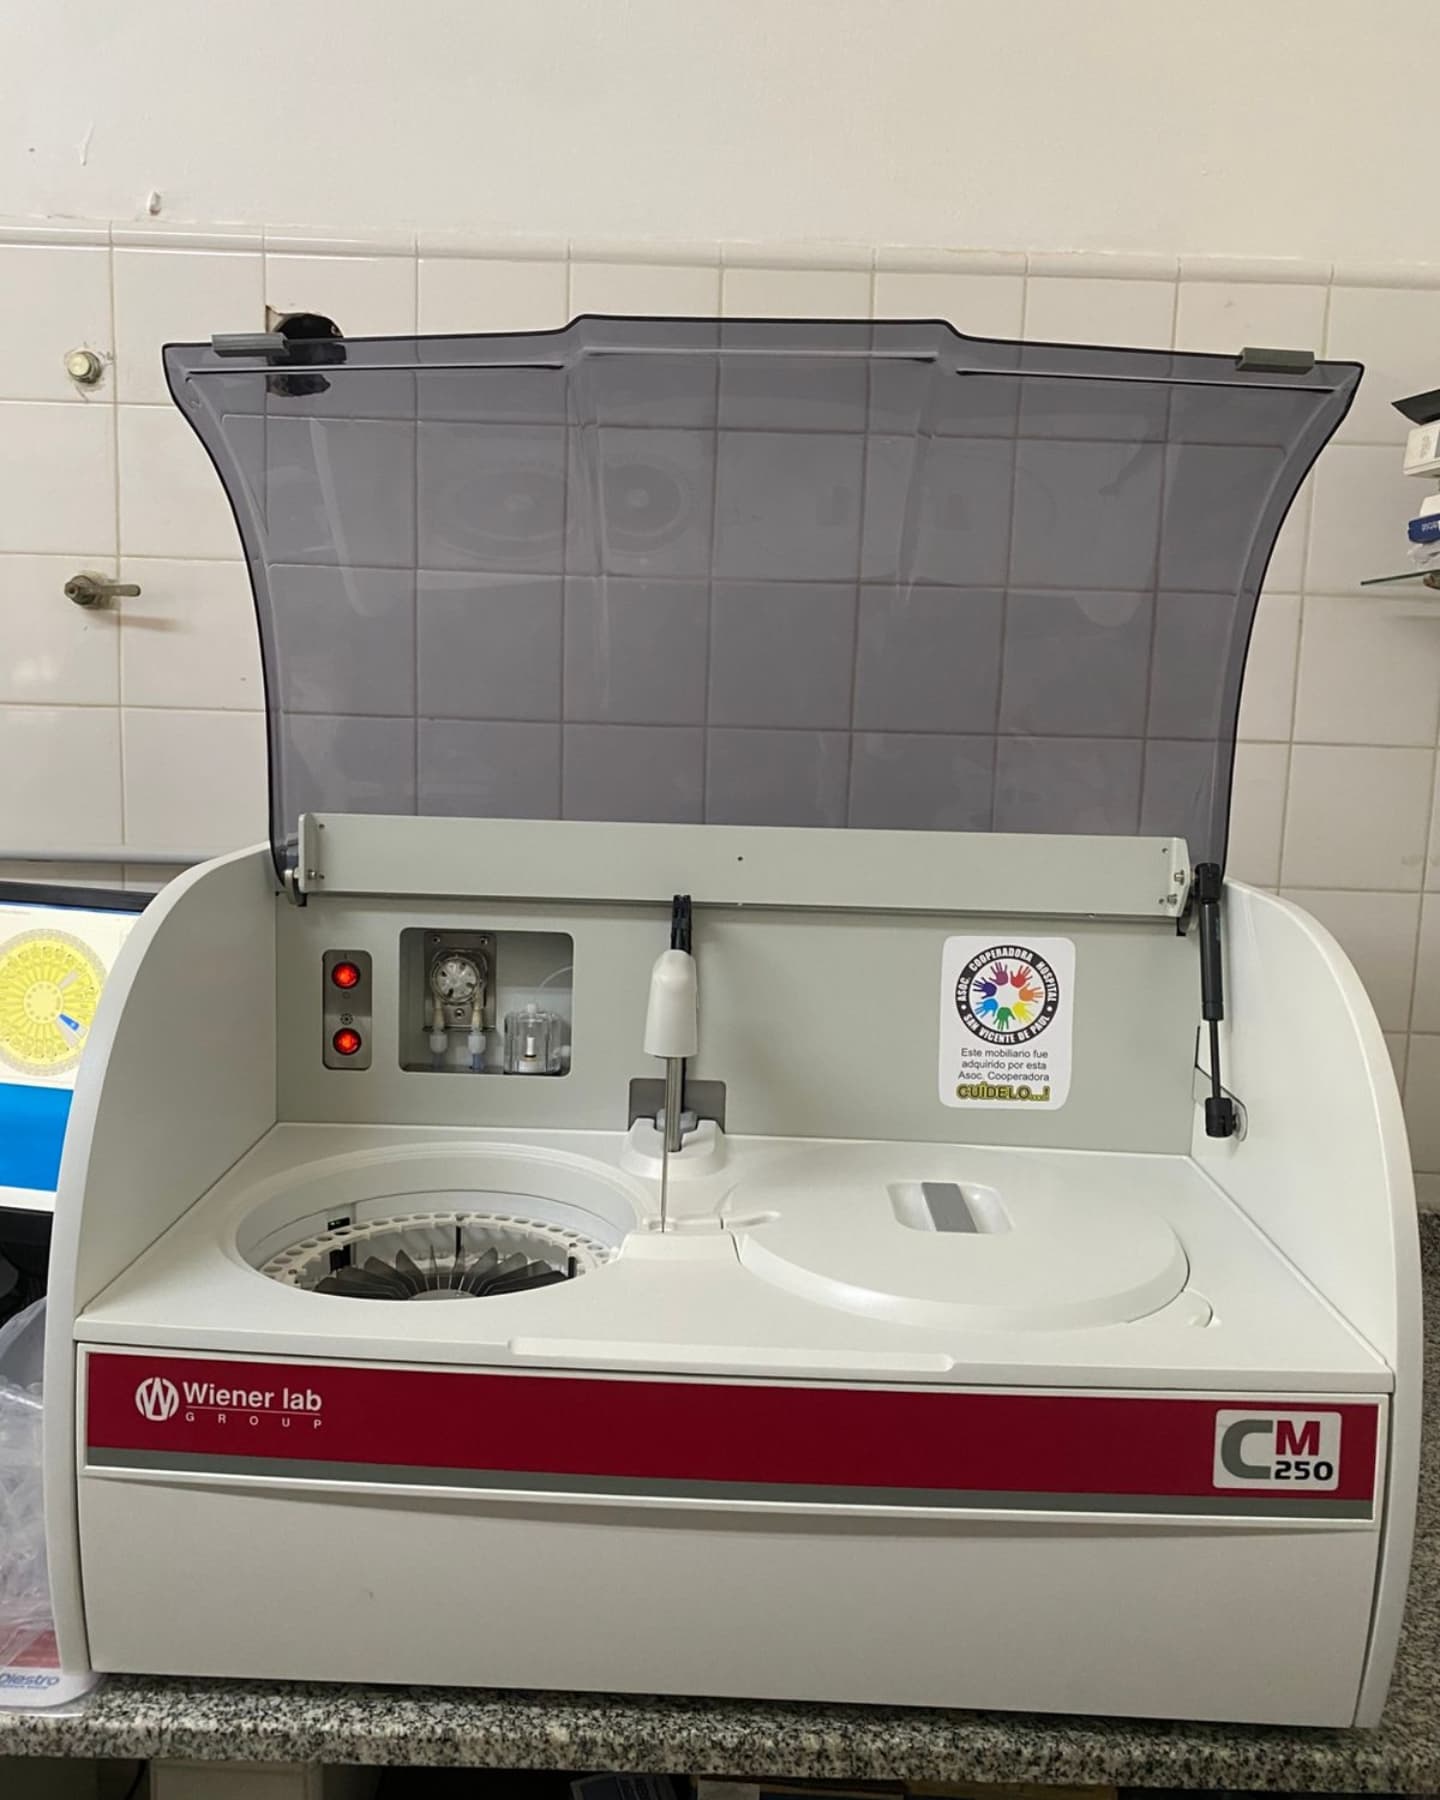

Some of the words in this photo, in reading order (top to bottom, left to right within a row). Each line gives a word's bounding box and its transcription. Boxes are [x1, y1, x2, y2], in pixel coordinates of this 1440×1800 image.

[969, 947, 1033, 972] COOPERADORA
[1035, 960, 1058, 1002] HOSPITAL
[962, 1014, 980, 1031] SAN
[979, 1027, 1016, 1043] VICENTE
[1017, 1030, 1031, 1042] DE
[1032, 1015, 1051, 1035] PAUL
[960, 1047, 983, 1058] Este
[984, 1048, 1031, 1058] mobiliario
[1032, 1049, 1049, 1059] fue
[961, 1059, 1006, 1071] adquirido
[1007, 1061, 1024, 1071] por
[1026, 1061, 1047, 1070] esta
[958, 1071, 984, 1081] Asoc.
[986, 1071, 1050, 1083] Cooperadora
[182, 1381, 274, 1409] Wiener
[282, 1387, 322, 1412] lab
[1274, 1460, 1334, 1481] 250
